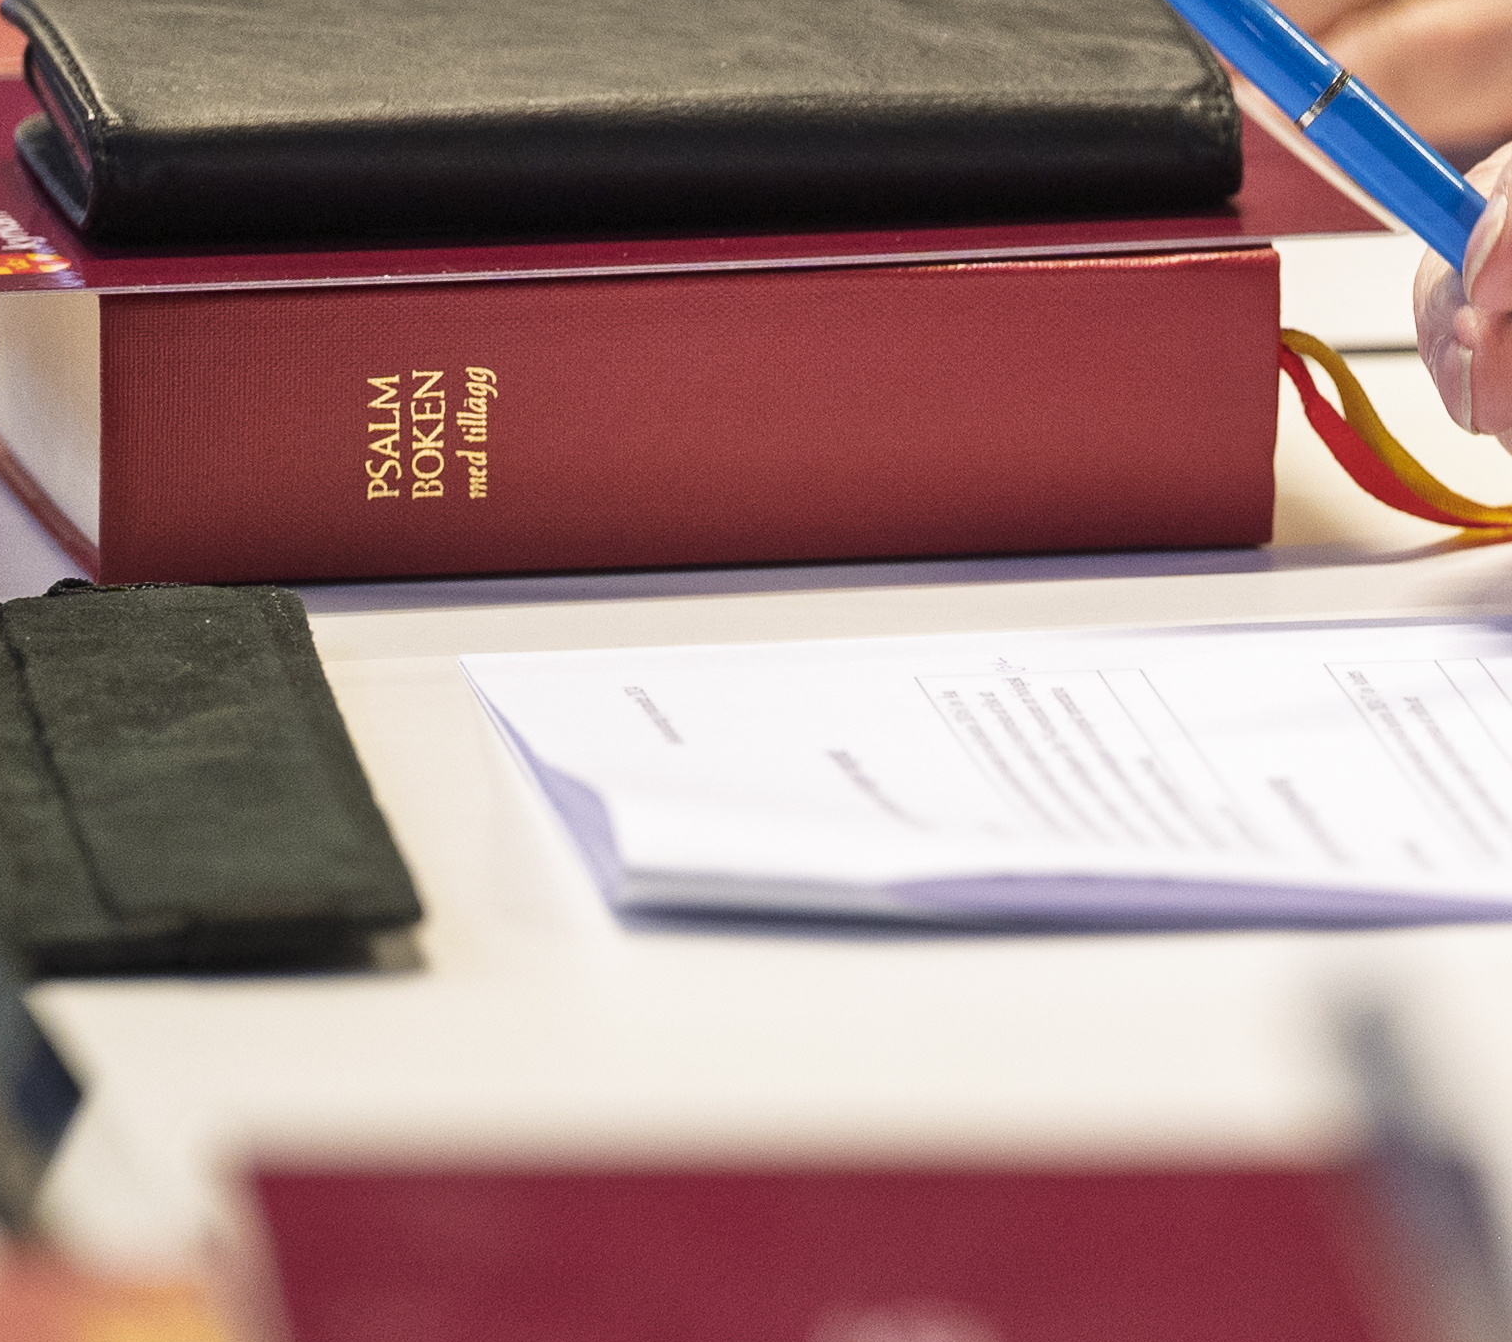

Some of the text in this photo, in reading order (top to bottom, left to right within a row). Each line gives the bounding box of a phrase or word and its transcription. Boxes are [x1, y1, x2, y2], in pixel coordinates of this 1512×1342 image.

[365, 374, 402, 500] PSALM
[411, 370, 446, 500] BOKEN
[455, 366, 498, 499] med tillägg
